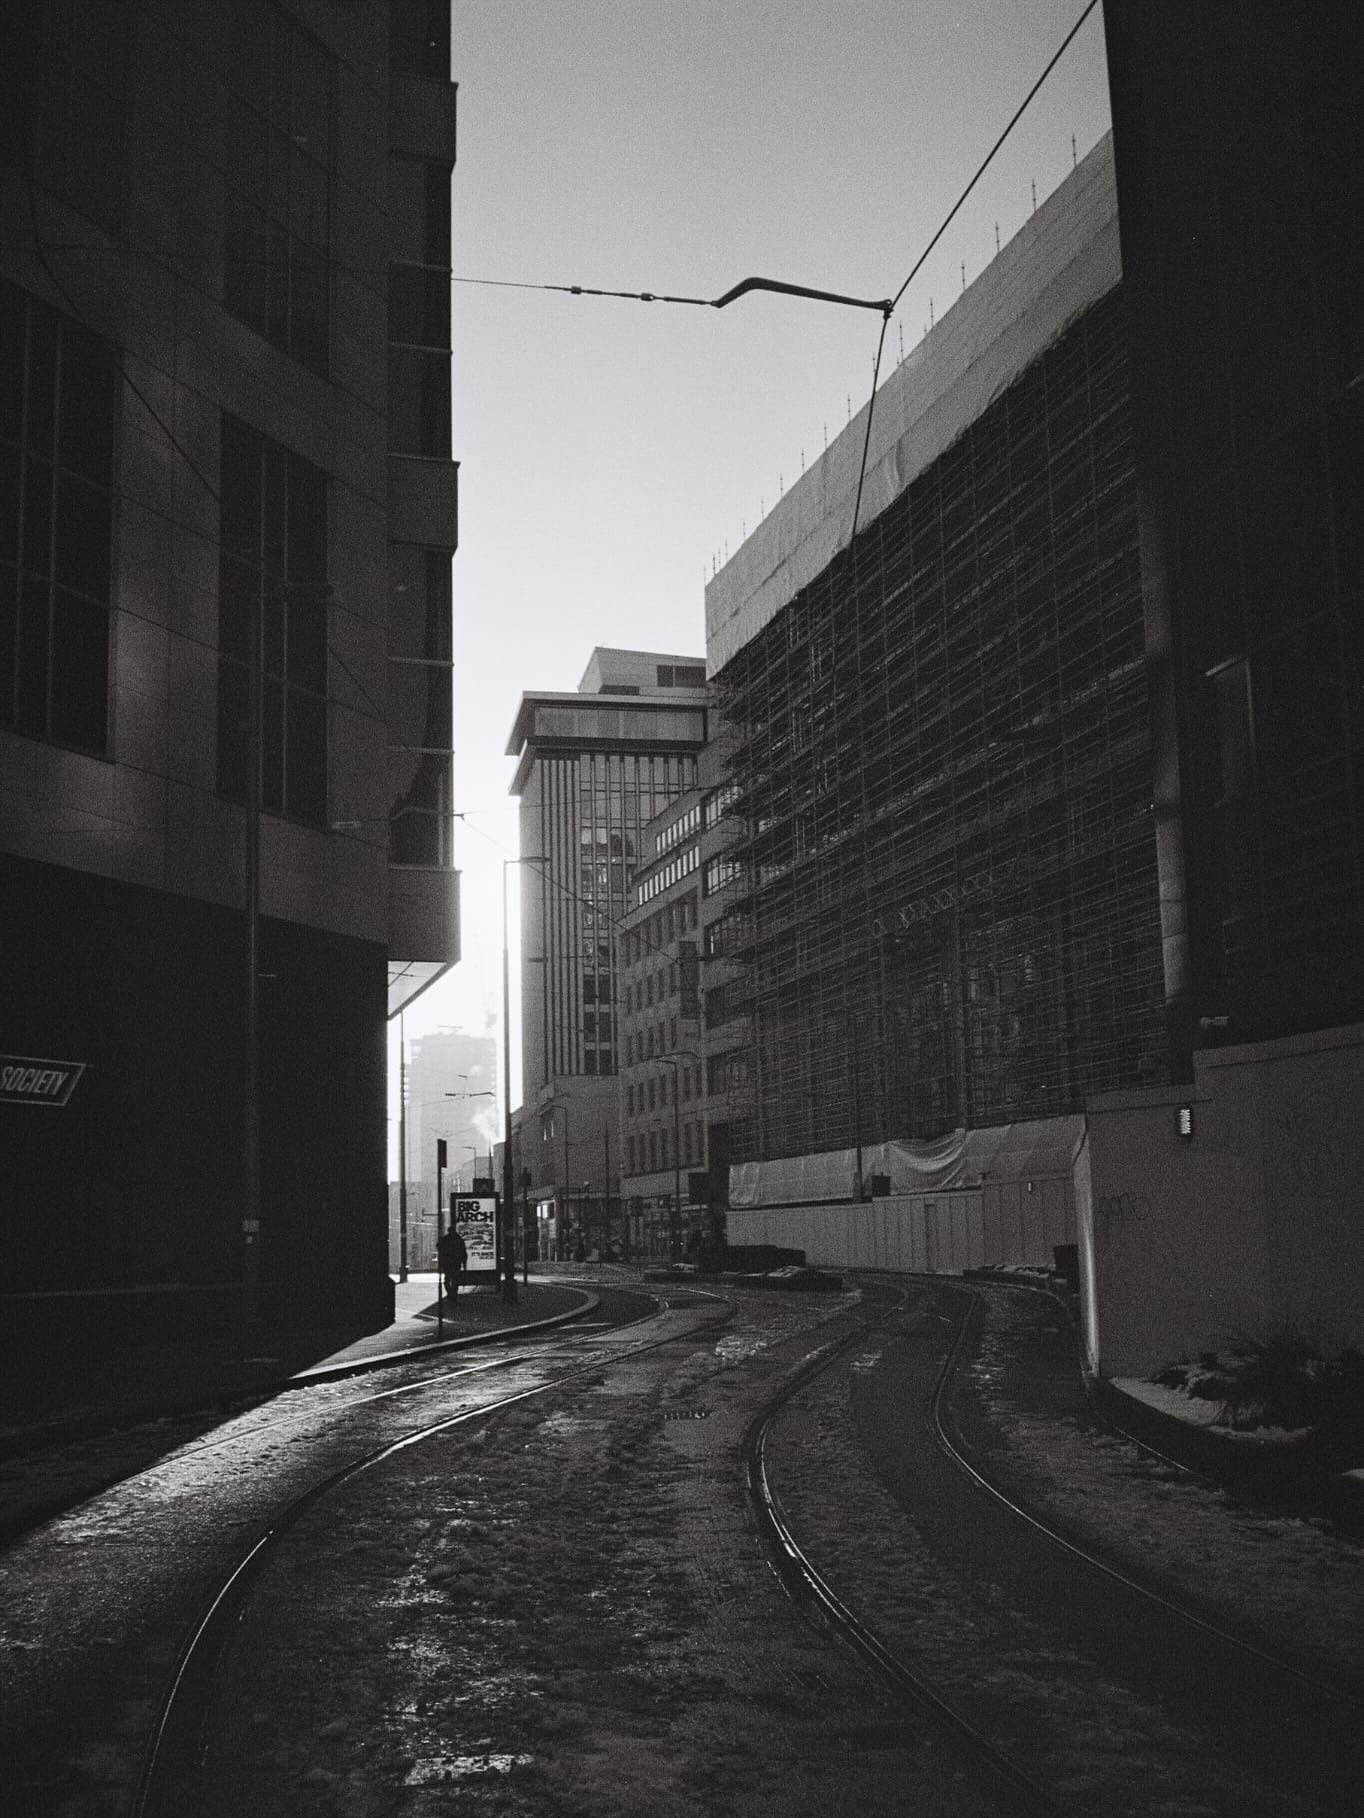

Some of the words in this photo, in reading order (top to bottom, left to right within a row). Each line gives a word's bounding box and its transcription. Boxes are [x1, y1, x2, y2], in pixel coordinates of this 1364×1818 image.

[0, 1066, 70, 1095] SOCIETY
[458, 1201, 481, 1212] BIG
[457, 1211, 494, 1222] ARCH
